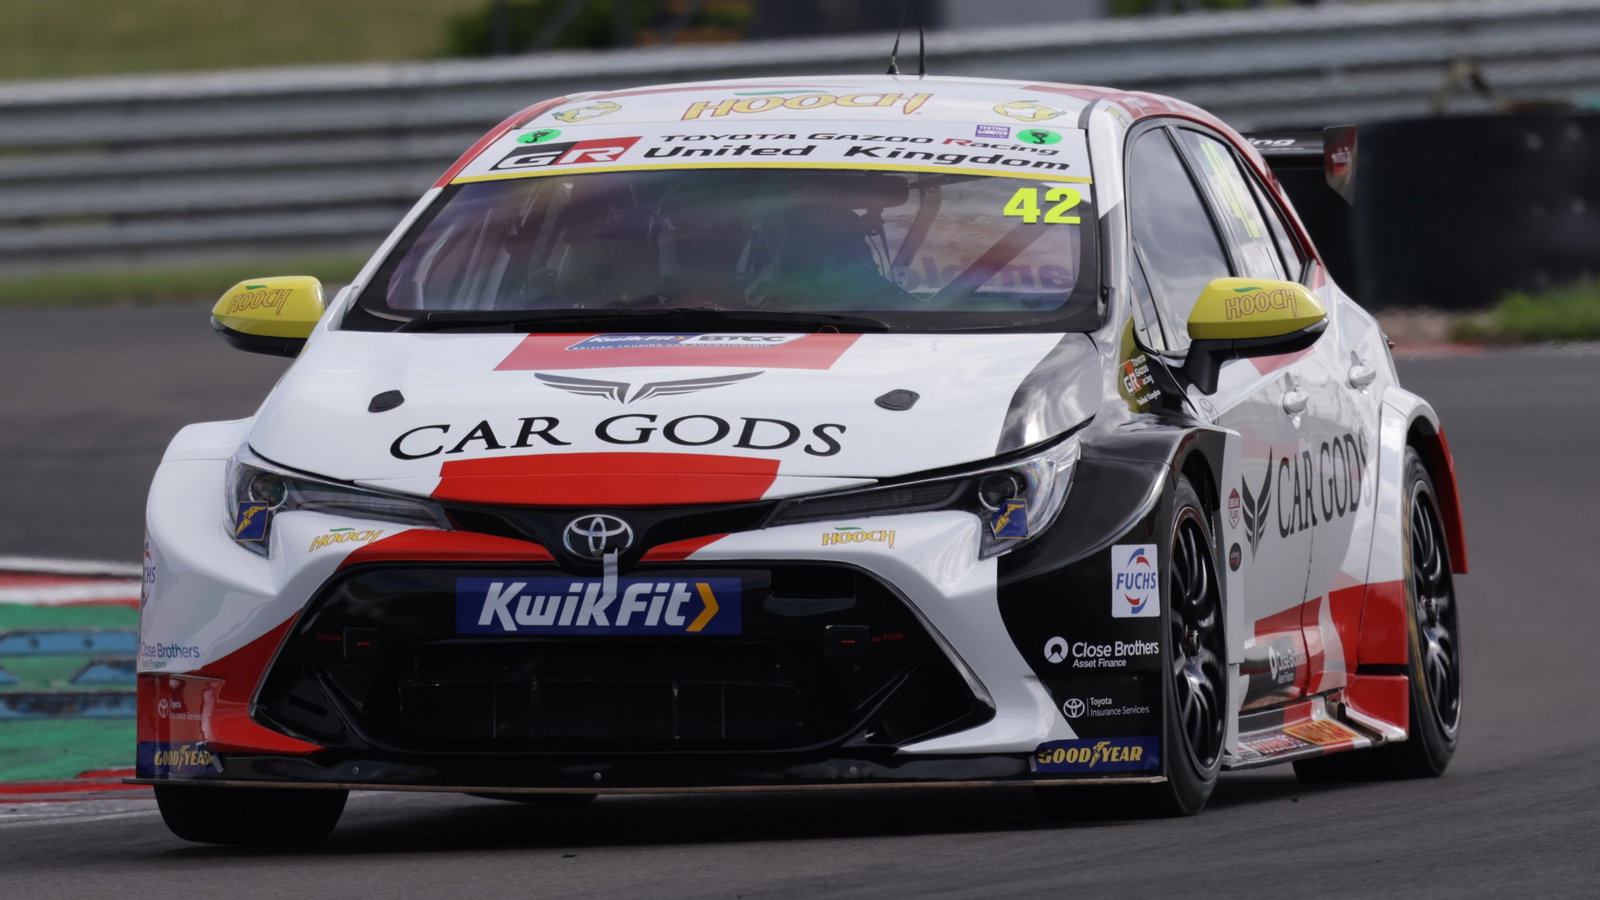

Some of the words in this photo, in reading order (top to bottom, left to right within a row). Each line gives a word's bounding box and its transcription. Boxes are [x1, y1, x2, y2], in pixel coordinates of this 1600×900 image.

[681, 93, 934, 121] HOOCH
[661, 133, 797, 143] TOYOTA
[942, 138, 1060, 156] Racing
[495, 146, 628, 170] GR
[643, 144, 817, 158] United
[843, 145, 1070, 171] Kingdom
[1003, 187, 1082, 224] 42
[225, 288, 294, 316] HOOCH
[1224, 288, 1298, 321] HOOCH
[389, 416, 573, 461] CAR
[594, 413, 848, 457] GODS
[1277, 450, 1318, 539] CAR
[1320, 427, 1372, 522] GODS
[309, 529, 385, 553] HOOCH
[821, 529, 896, 549] HOOCH
[1115, 571, 1157, 590] FUCHS
[157, 643, 200, 659] Brothers
[1072, 641, 1112, 658] Close
[1114, 640, 1160, 657] Brothers
[1072, 658, 1097, 669] Asset
[1098, 658, 1127, 668] Finance
[1090, 697, 1113, 708] Toyota
[1090, 708, 1121, 717] Insurance
[1122, 705, 1150, 715] Services
[1038, 744, 1143, 766] GOODYEAR
